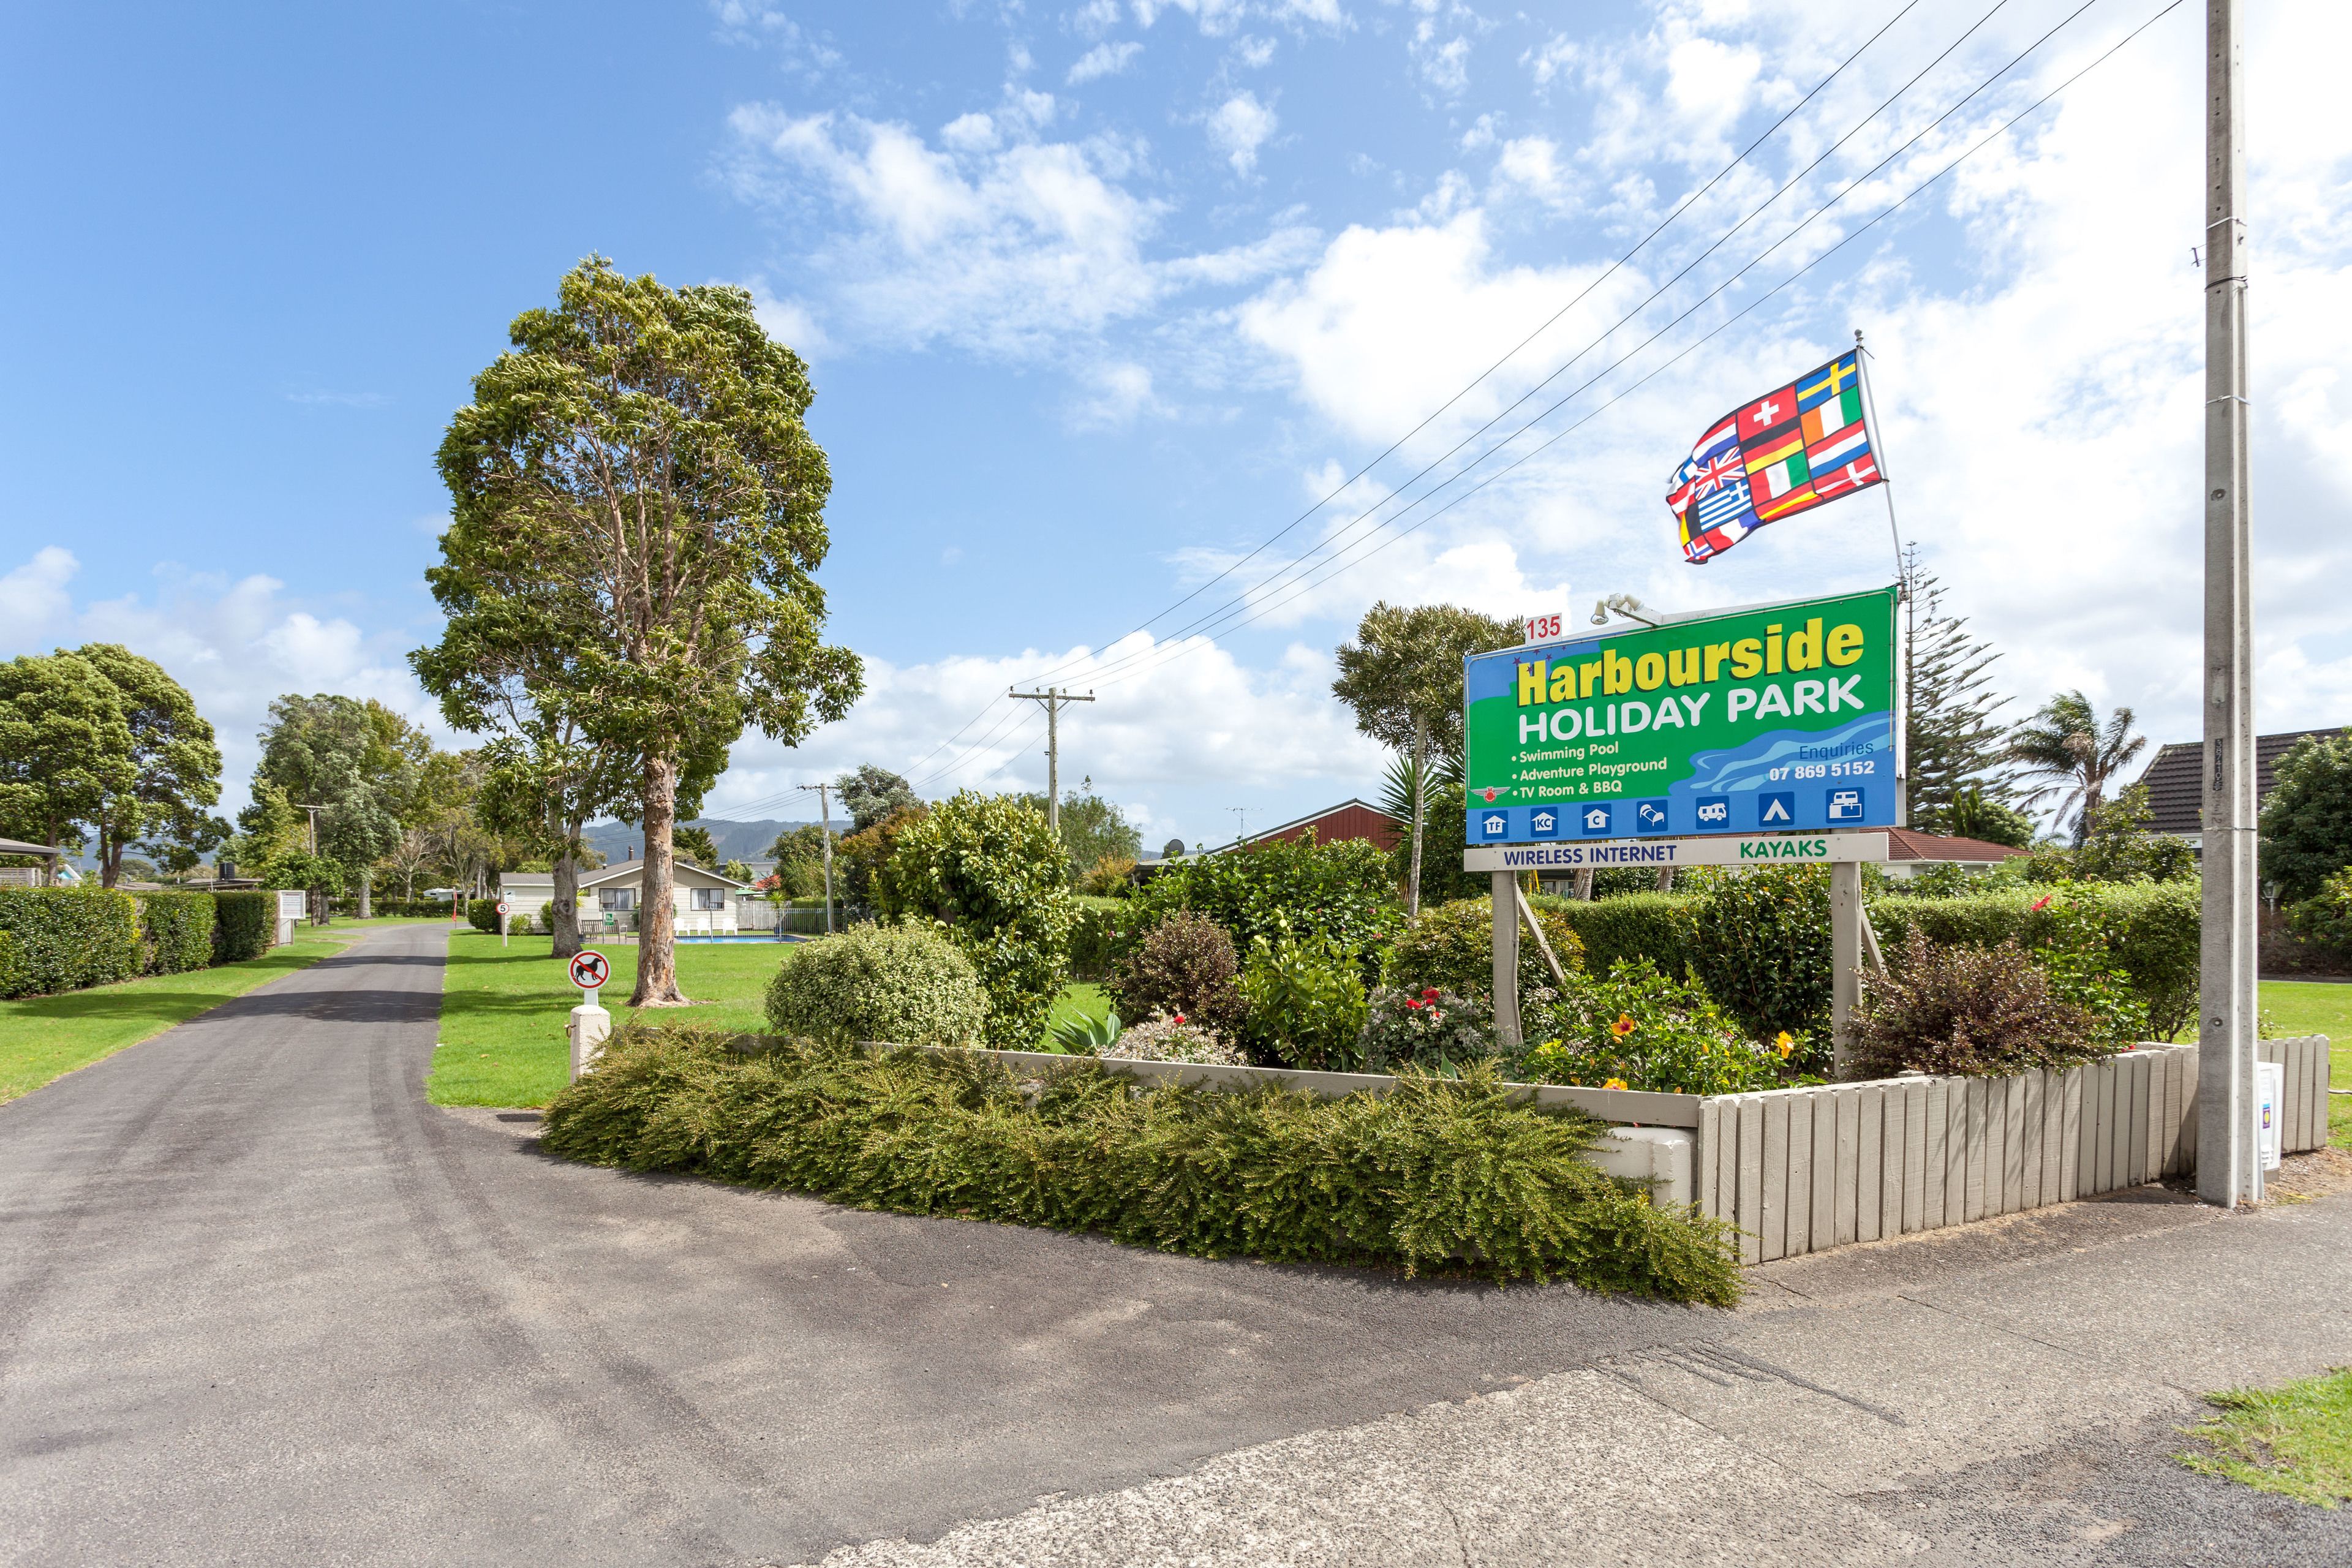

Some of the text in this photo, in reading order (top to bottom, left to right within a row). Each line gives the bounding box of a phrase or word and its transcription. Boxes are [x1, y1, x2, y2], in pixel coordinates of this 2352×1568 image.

[1527, 616, 1560, 639] 135
[1518, 617, 1864, 707] Harbourside
[1519, 674, 1864, 744] HOLIDAY PARK
[1520, 741, 1618, 763] Swimming Pool
[1800, 742, 1874, 760] Enquiries
[1520, 757, 1667, 781] Adventure Playground
[1770, 761, 1874, 781] 07 869 5152
[1520, 780, 1622, 798] TV Room & BBQ
[1489, 822, 1500, 831] TF
[1537, 818, 1550, 827] KC
[1593, 815, 1600, 825] C
[1504, 845, 1677, 865] WIRELESS INTERNET
[1740, 839, 1827, 859] KAYAKS
